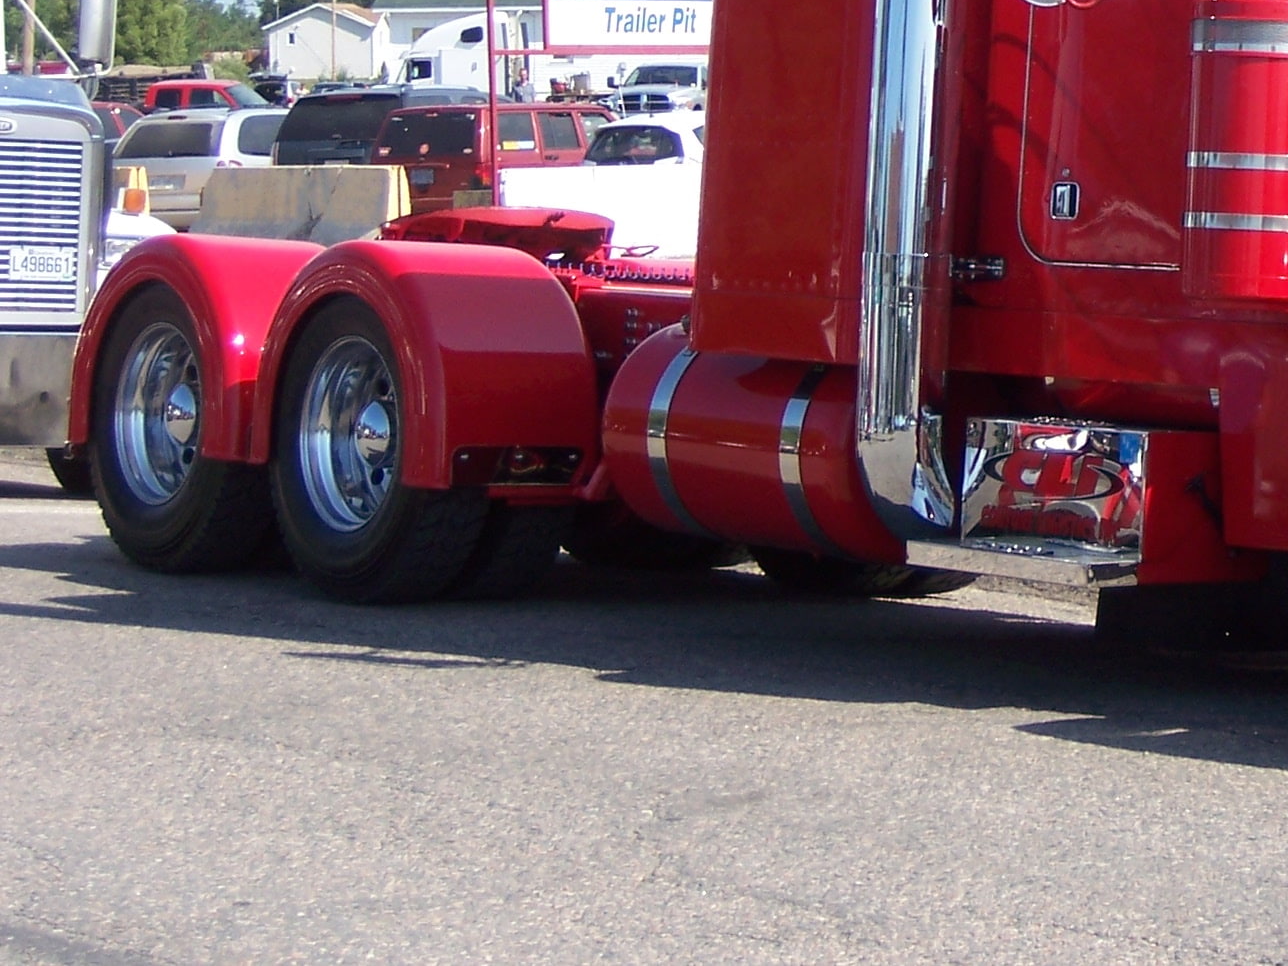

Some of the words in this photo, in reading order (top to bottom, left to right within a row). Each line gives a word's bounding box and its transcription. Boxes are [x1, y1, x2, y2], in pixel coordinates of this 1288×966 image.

[604, 7, 666, 33] Trailer
[672, 7, 697, 33] Pit
[12, 255, 71, 274] L498661
